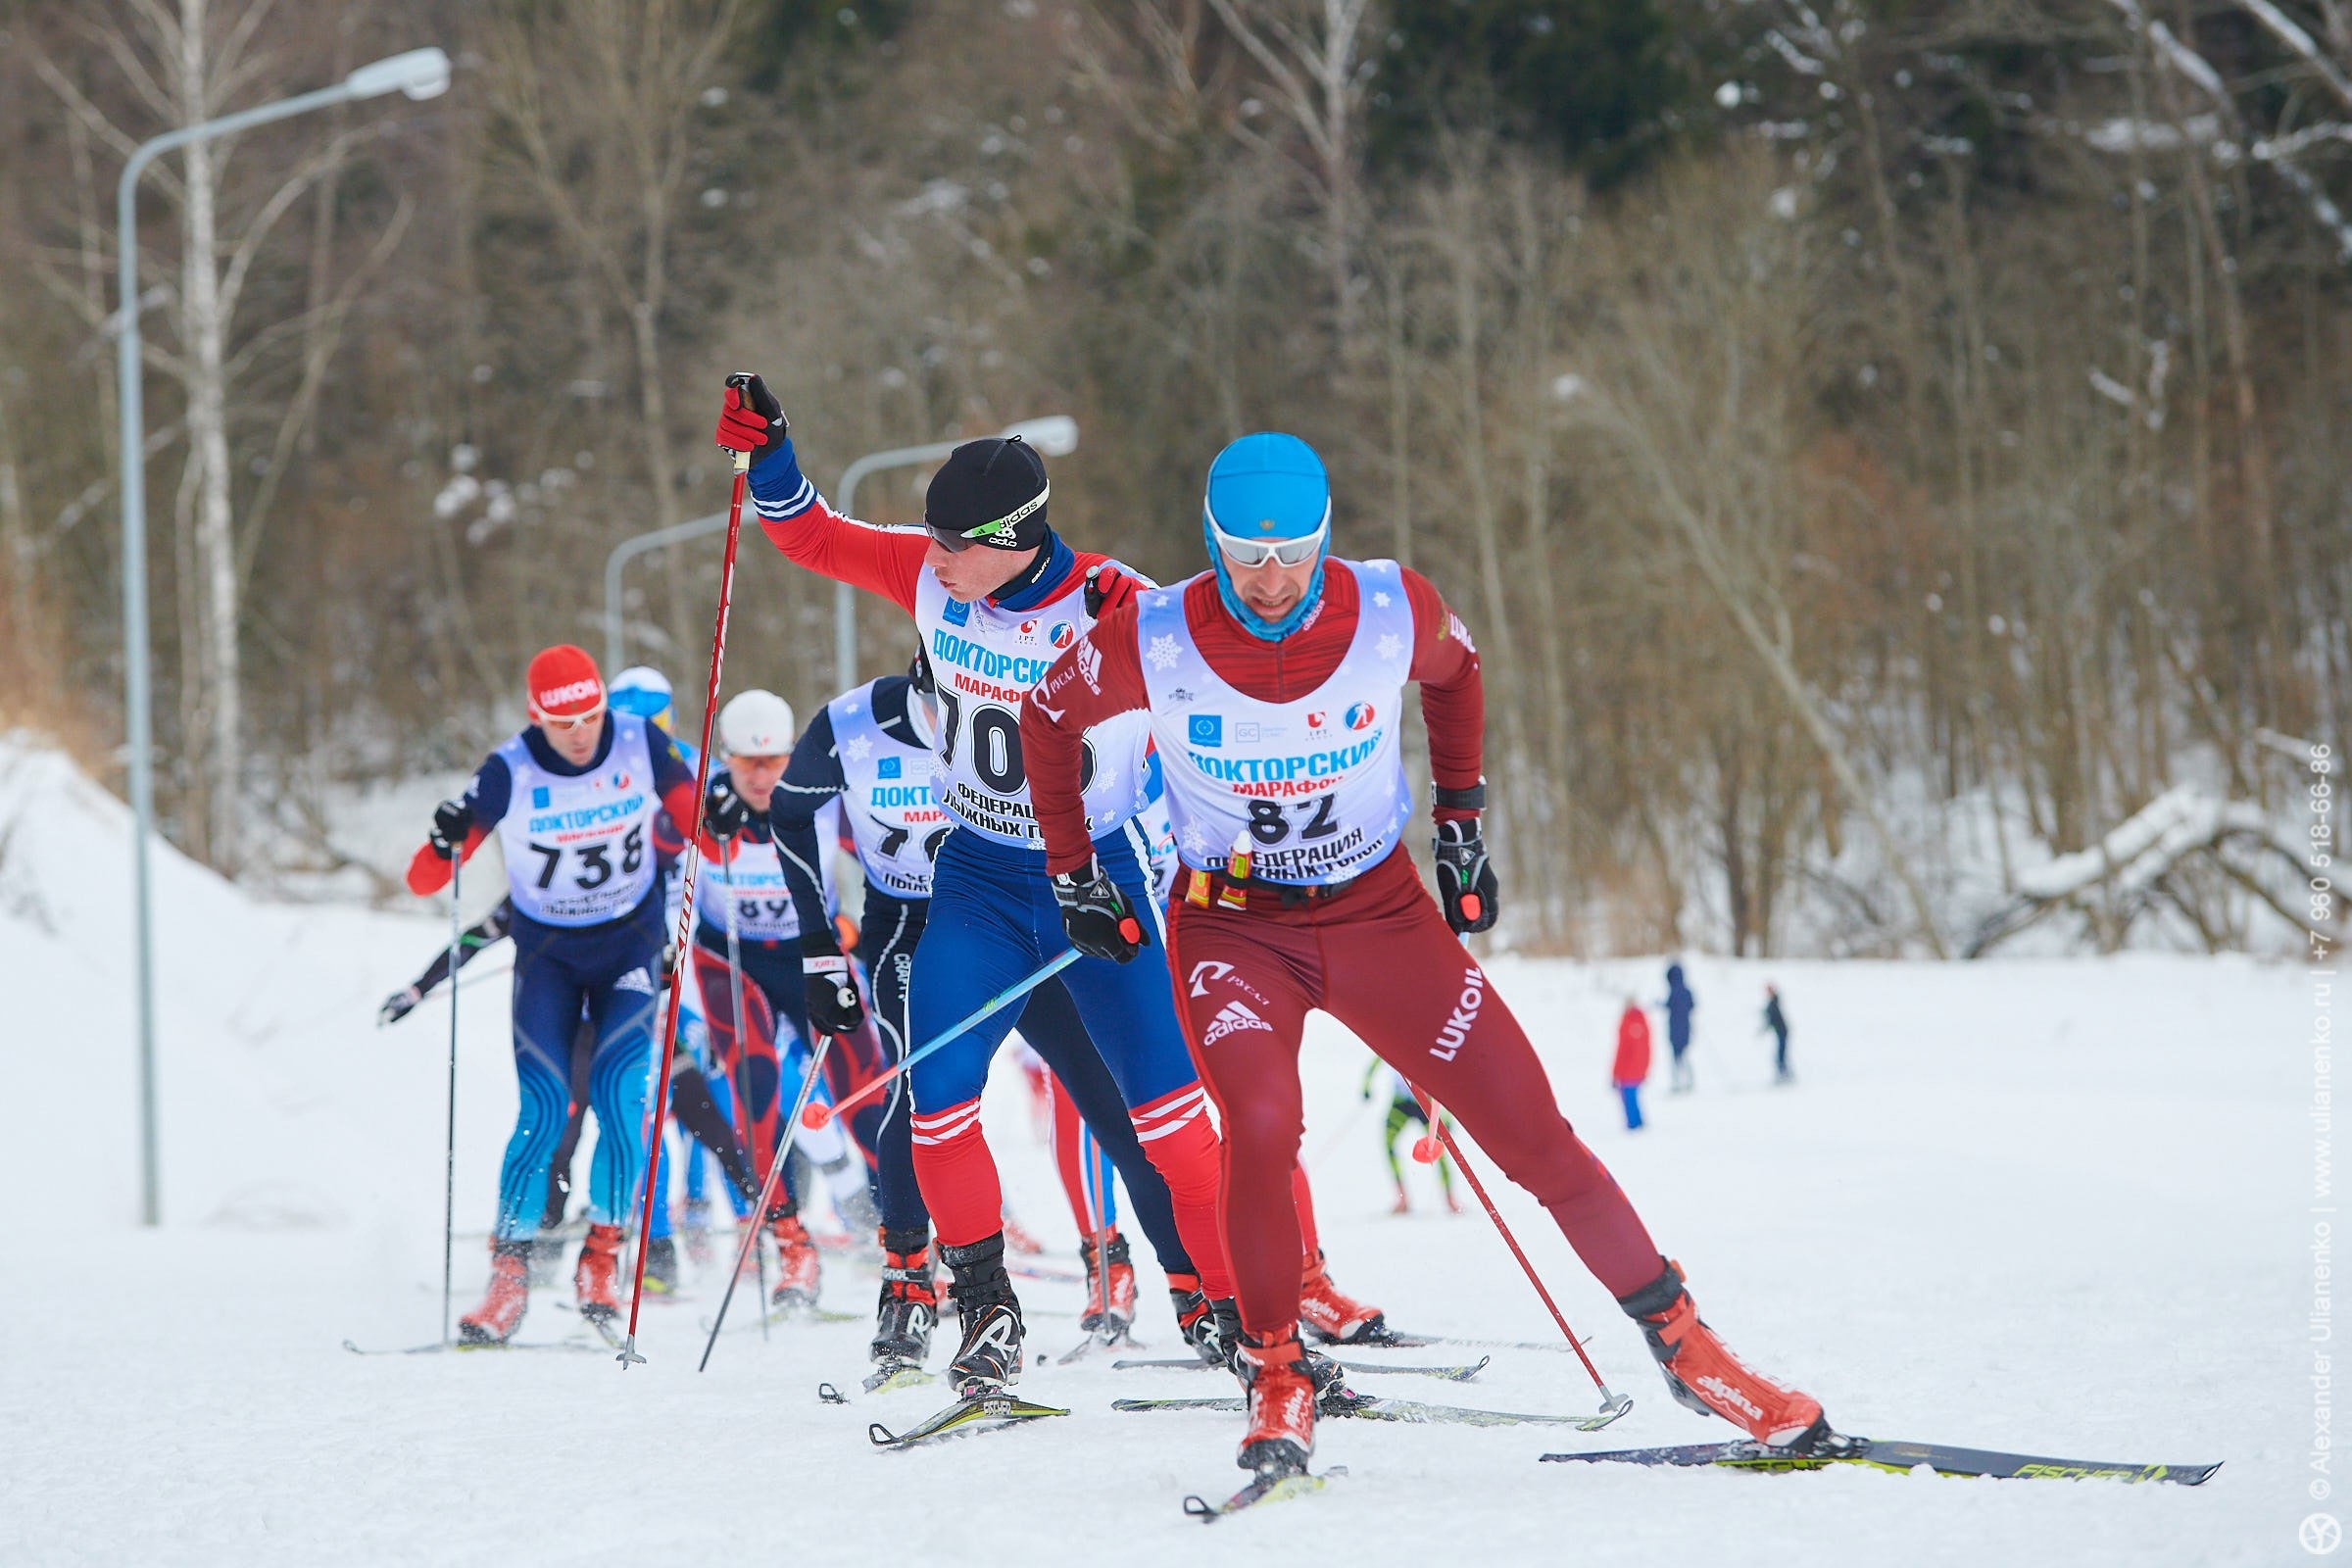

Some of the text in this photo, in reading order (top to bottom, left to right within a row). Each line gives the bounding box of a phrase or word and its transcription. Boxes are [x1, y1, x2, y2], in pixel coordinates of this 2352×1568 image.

[989, 537, 1017, 548] odlo
[1303, 599, 1326, 632] adidas
[933, 628, 1054, 685] ДОКТОРСК
[955, 672, 1029, 704] МАРАФ
[1050, 666, 1077, 694] РУСАЛ
[936, 681, 1097, 796] 70
[871, 786, 939, 808] ДОКТ
[943, 788, 1022, 837] ЛЫЖНЫХ
[1247, 792, 1340, 846] 82
[530, 822, 643, 890] 738
[1204, 1017, 1273, 1047] adidas
[1429, 966, 1486, 1062] LUKOIL
[1695, 1375, 1764, 1421] alpina
